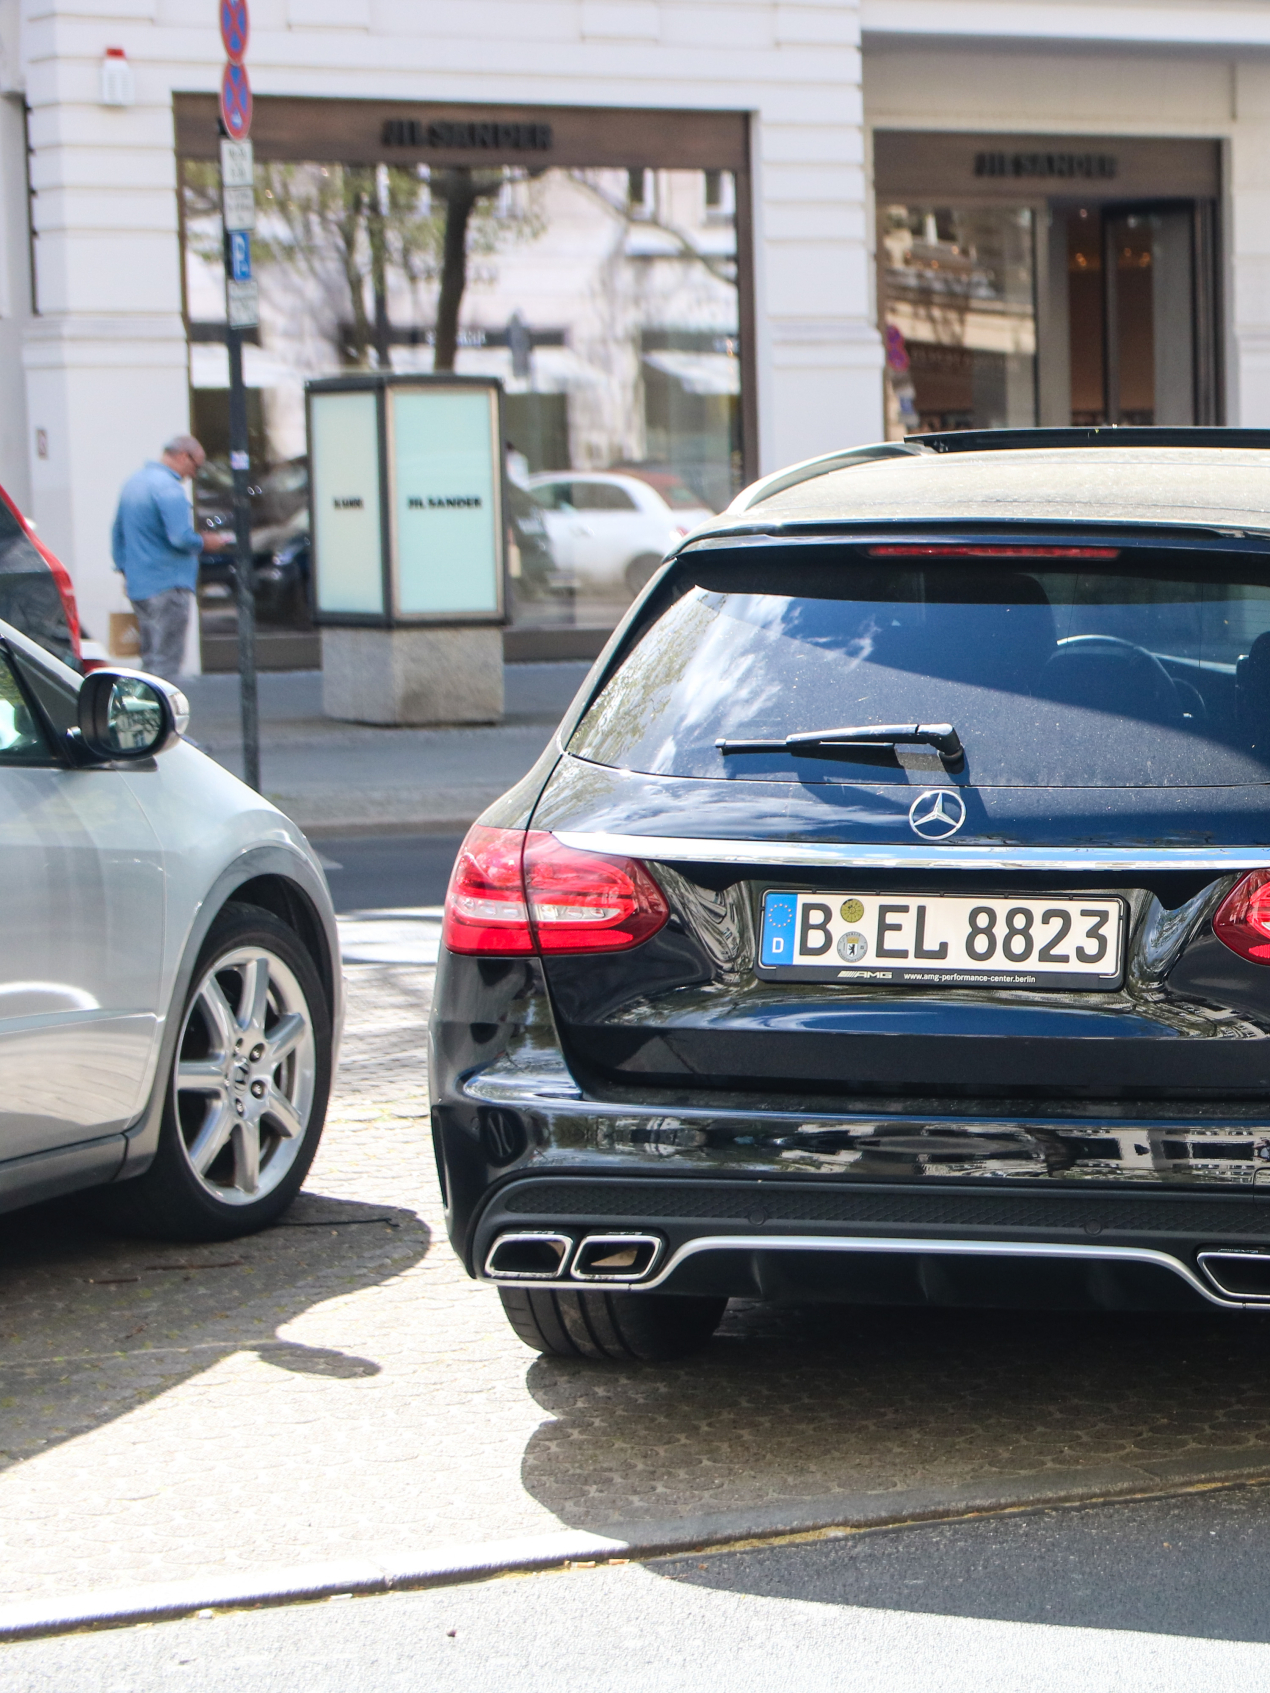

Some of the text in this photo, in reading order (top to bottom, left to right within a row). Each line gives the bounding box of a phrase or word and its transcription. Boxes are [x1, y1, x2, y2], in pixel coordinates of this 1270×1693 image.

[426, 496, 482, 509] SANDER
[772, 903, 1110, 964] D B EL 8823
[903, 972, 1036, 984] www.amg-performance-center.berlin
